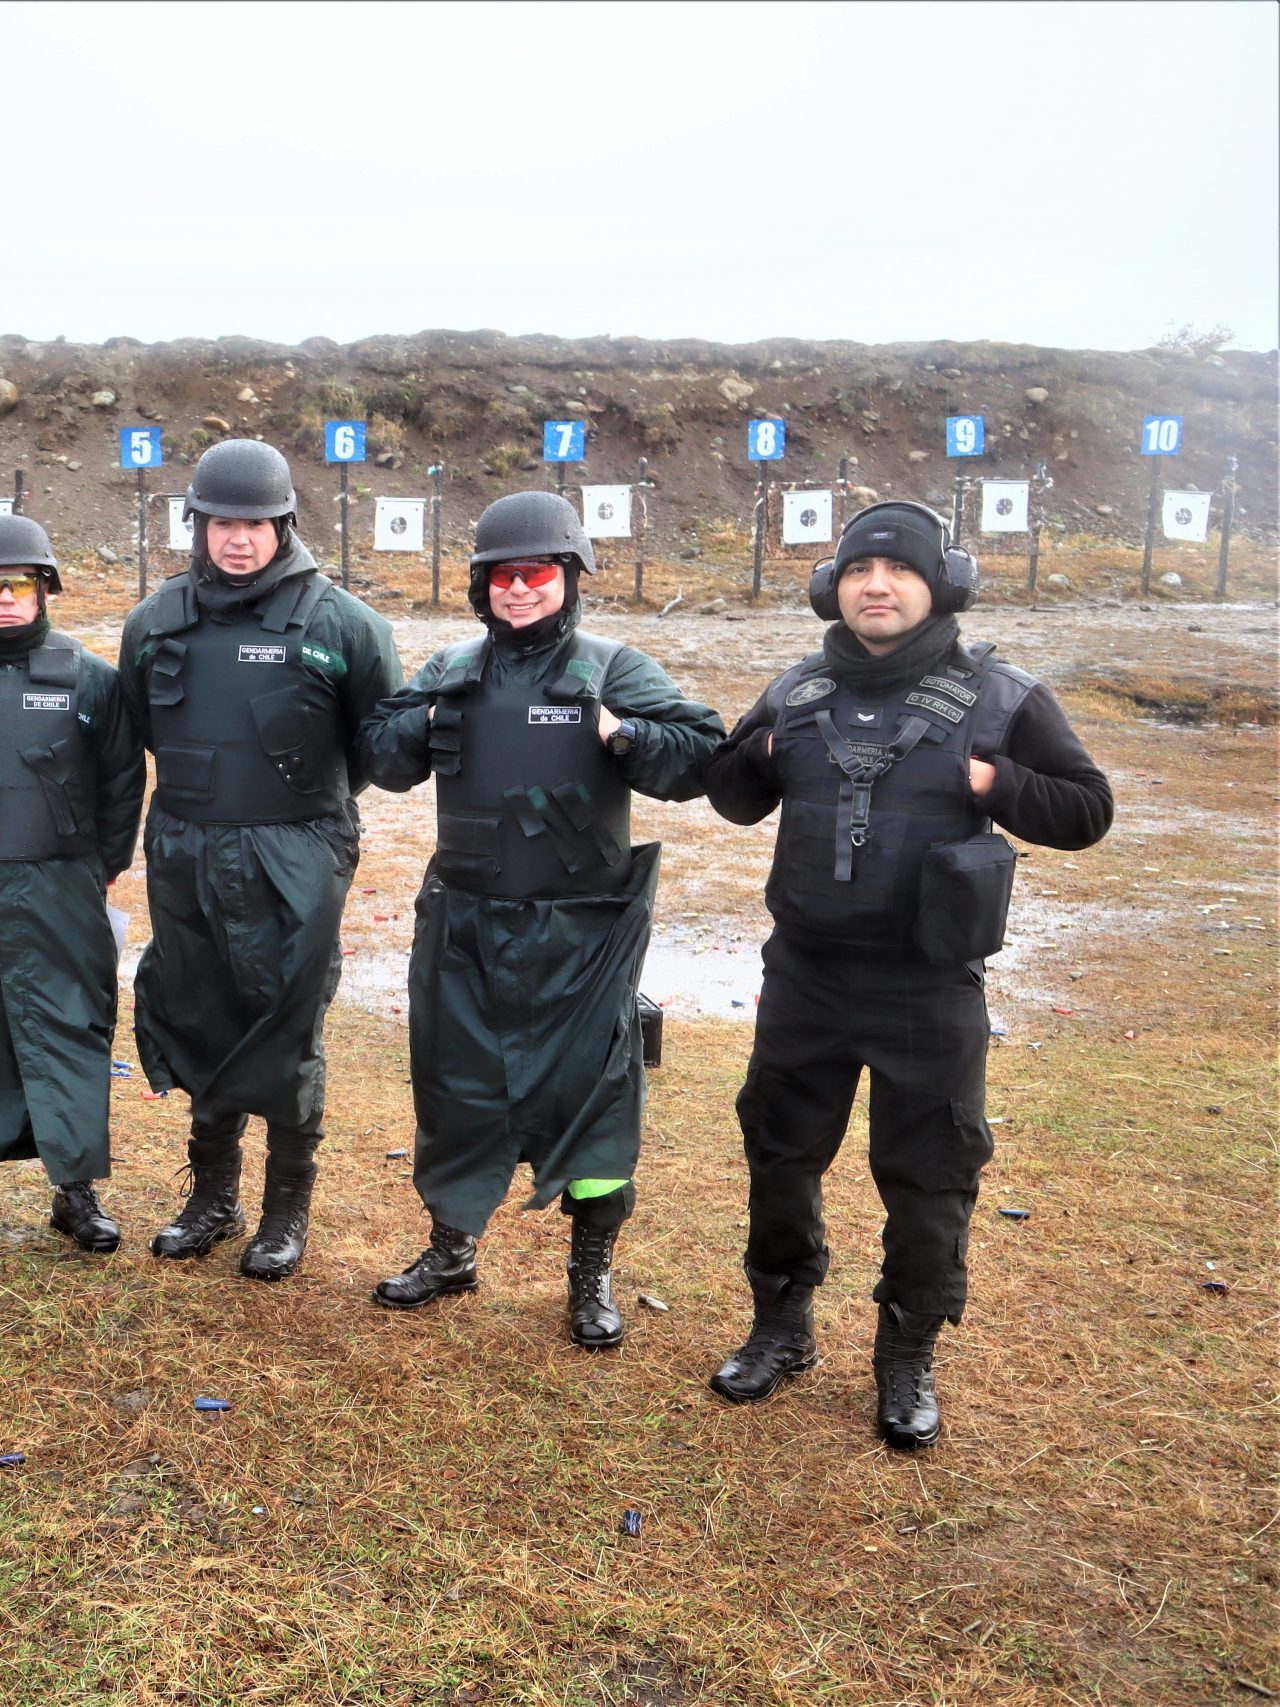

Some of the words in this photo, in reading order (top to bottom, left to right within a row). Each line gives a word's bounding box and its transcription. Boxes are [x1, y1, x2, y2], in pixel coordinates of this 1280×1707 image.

[131, 431, 154, 464] 5
[335, 426, 356, 459] 6
[556, 425, 573, 457] 7
[756, 422, 776, 456] 8
[955, 418, 976, 453] 9
[1146, 419, 1179, 451] 10
[241, 647, 283, 655] GENDARMERIA
[303, 646, 312, 656] DE
[313, 650, 330, 663] CHILE
[27, 695, 66, 703] GENDARMERIA
[925, 678, 971, 701] SOTOMAYOR
